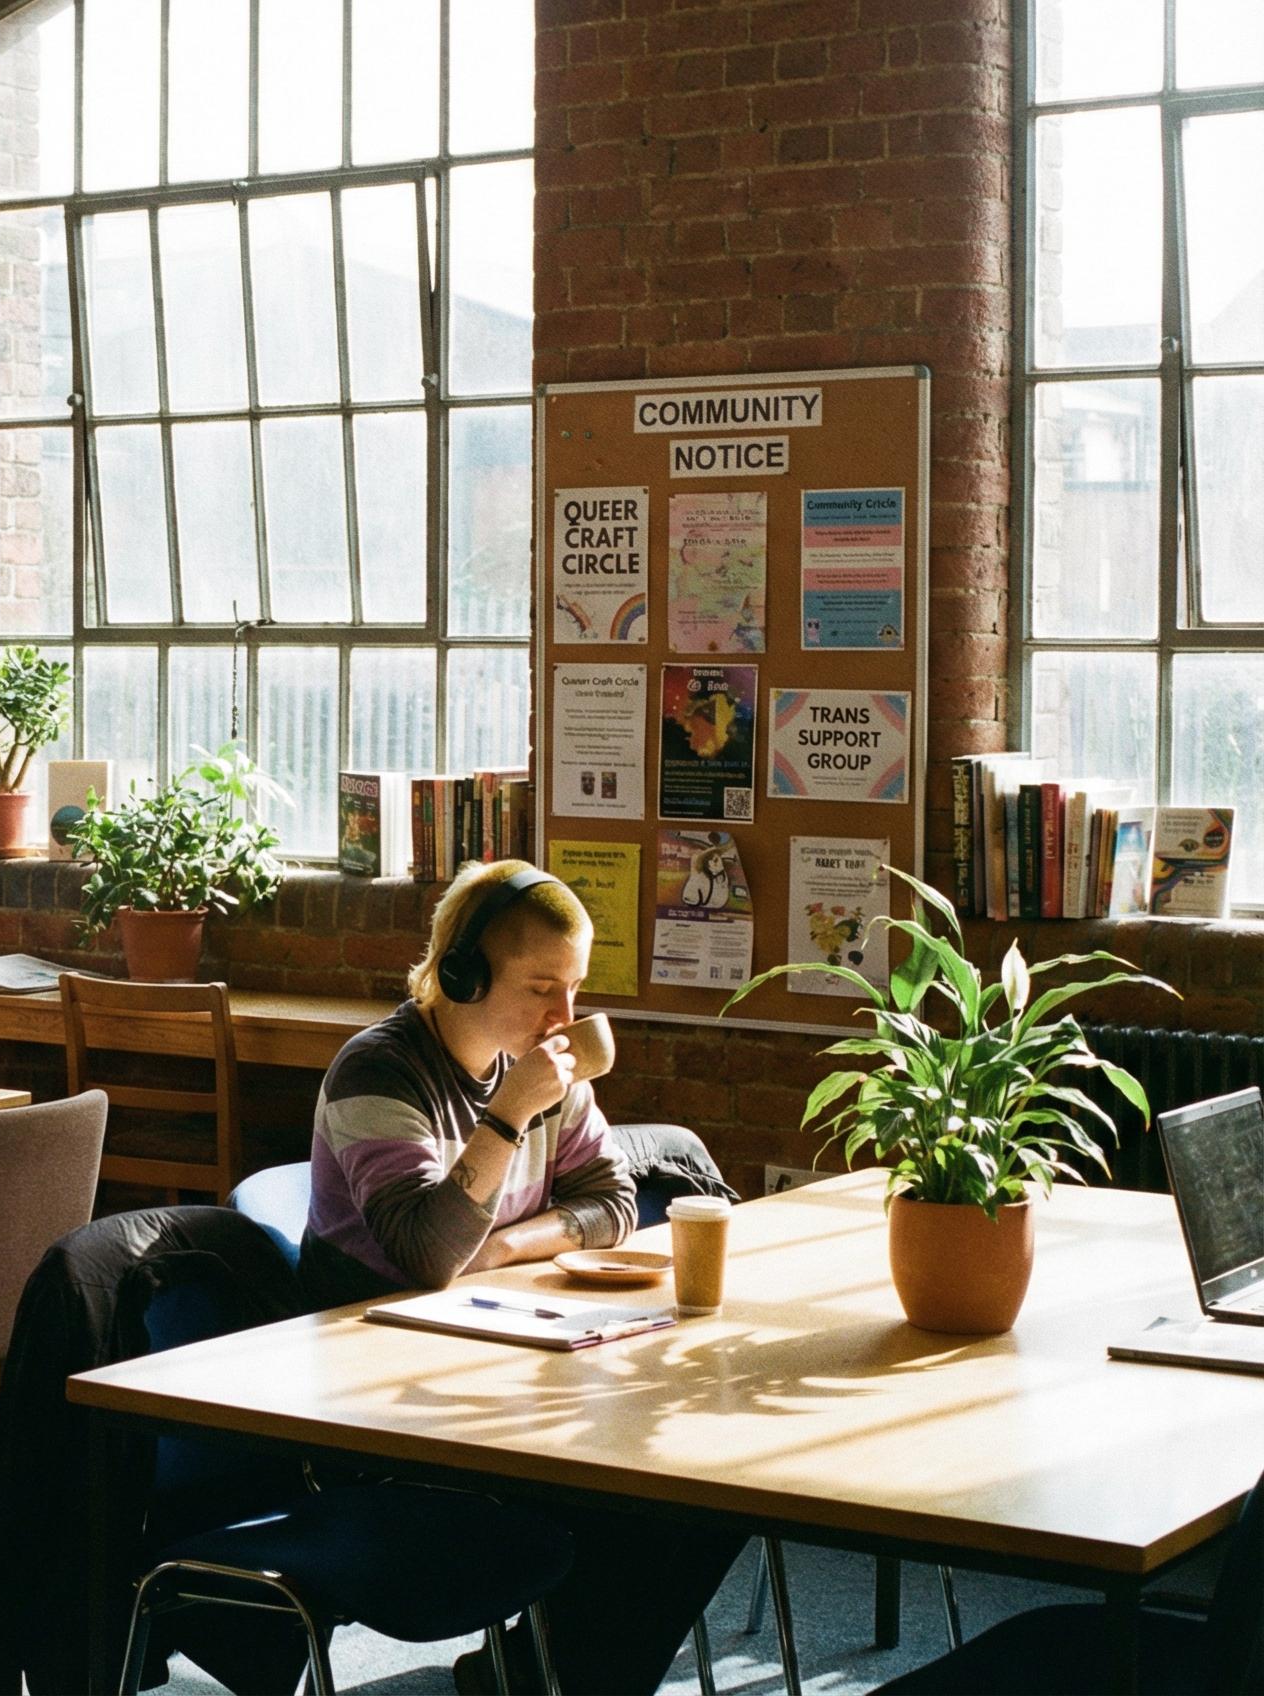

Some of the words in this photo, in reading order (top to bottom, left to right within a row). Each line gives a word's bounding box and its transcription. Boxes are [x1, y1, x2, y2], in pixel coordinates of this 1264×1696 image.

[639, 394, 819, 427] COMMUNITY
[675, 442, 784, 470] NOTICE
[564, 500, 638, 526] QUEER
[564, 527, 638, 549] CRAFT
[562, 553, 640, 575] CIRCLE
[810, 707, 870, 725] TRANS
[798, 730, 881, 749] SUPPORT
[807, 753, 871, 771] GROUP
